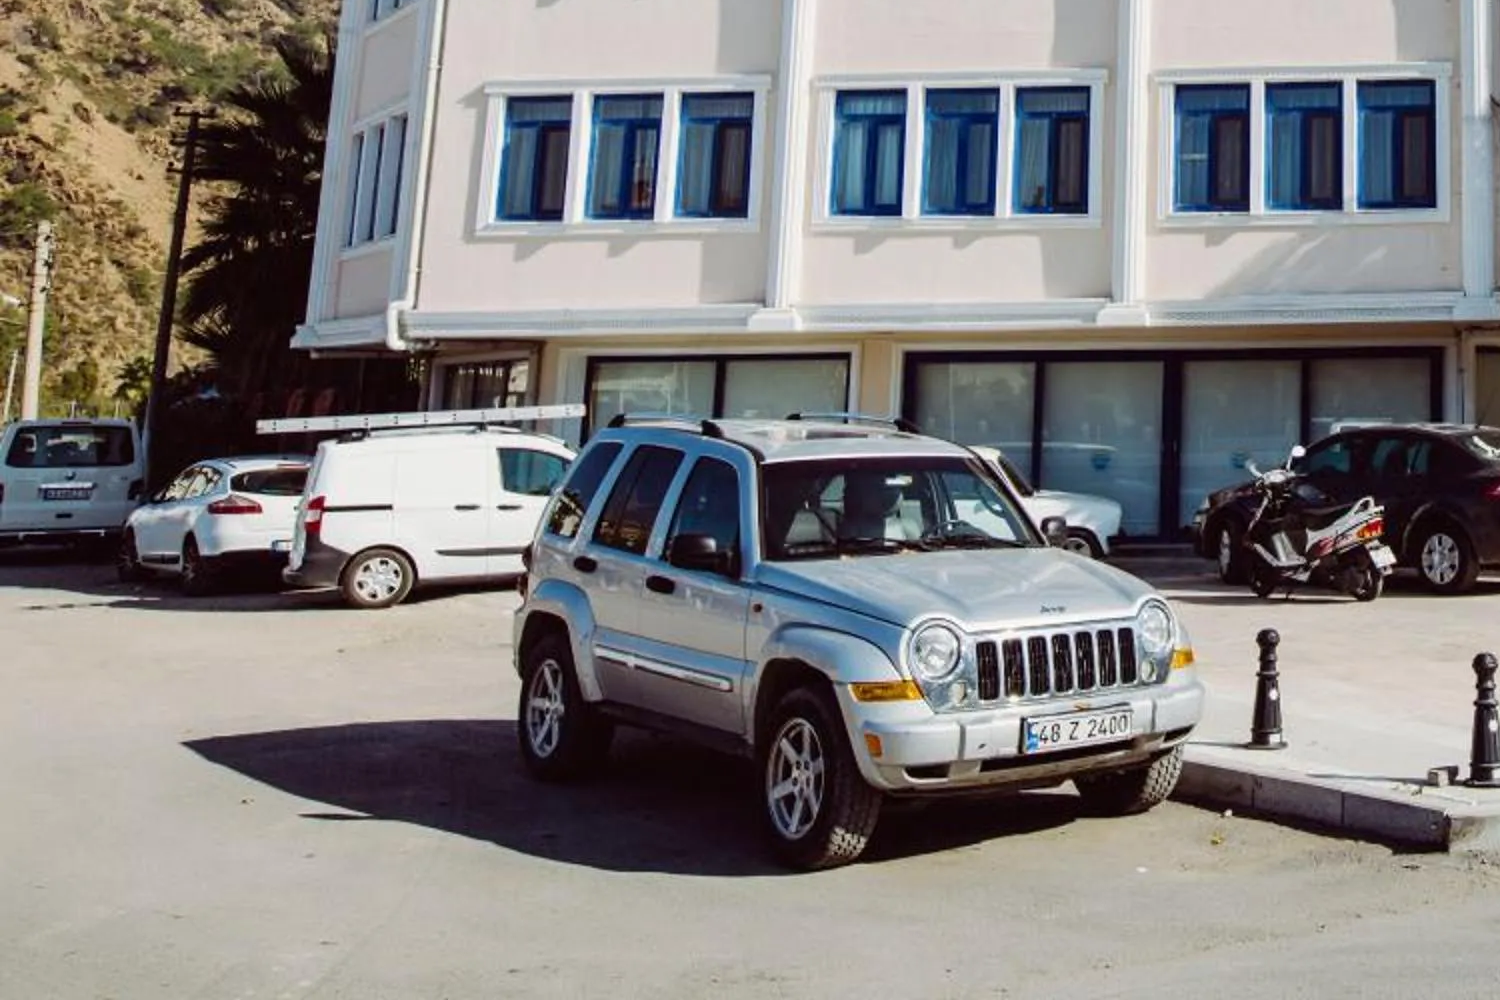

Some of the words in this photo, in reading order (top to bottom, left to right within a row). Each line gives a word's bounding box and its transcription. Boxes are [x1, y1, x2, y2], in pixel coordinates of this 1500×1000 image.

[1040, 723, 1061, 744] 48
[1069, 721, 1079, 740] Z
[1087, 714, 1129, 739] 2400
